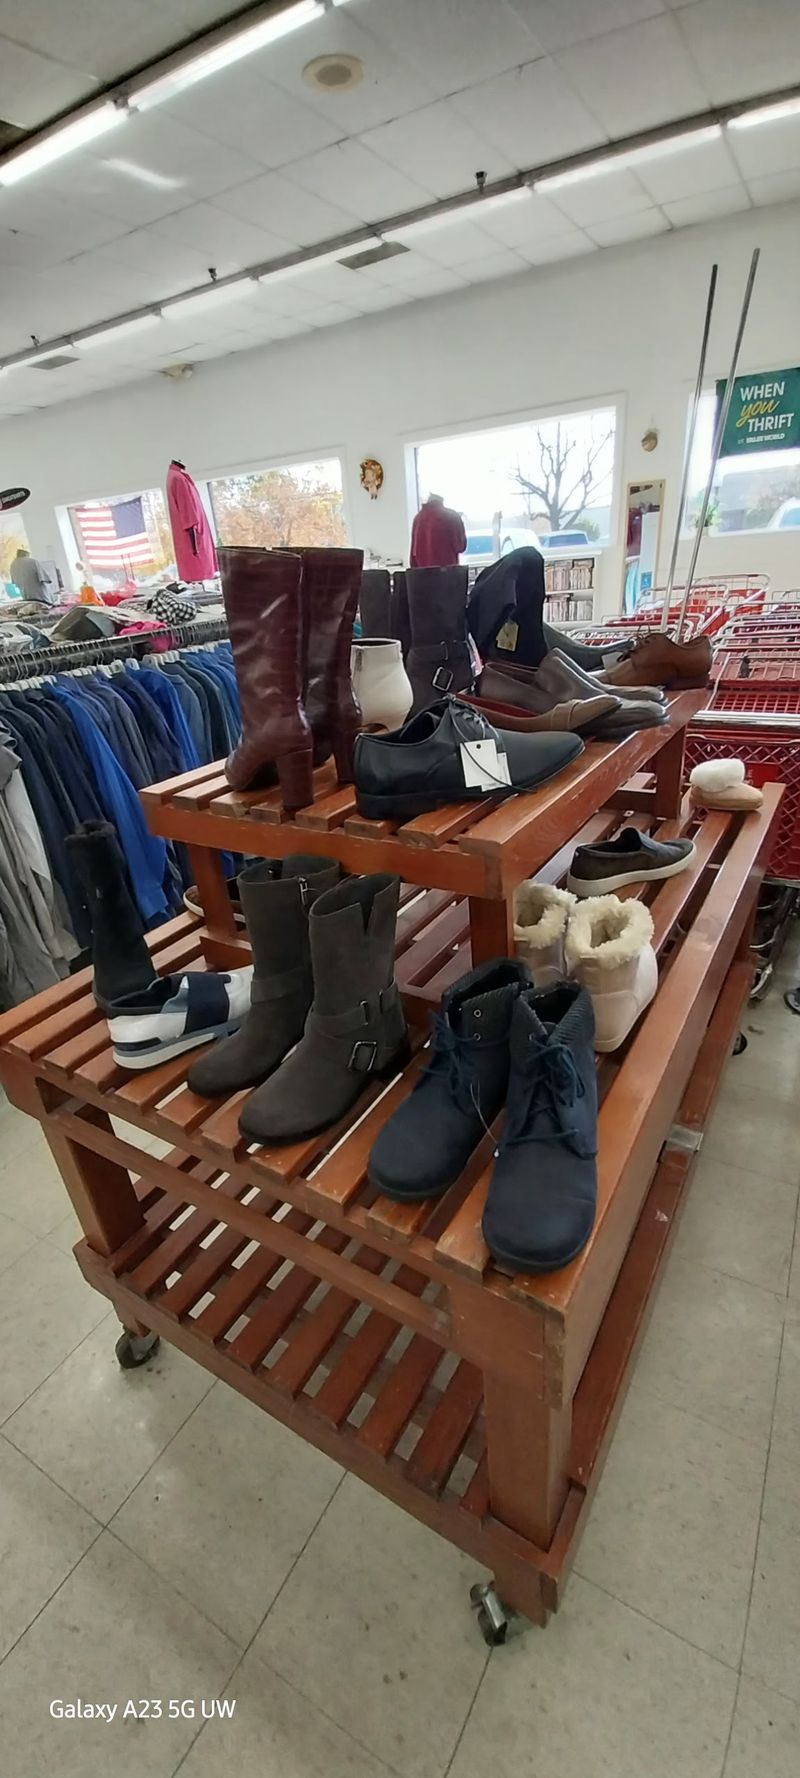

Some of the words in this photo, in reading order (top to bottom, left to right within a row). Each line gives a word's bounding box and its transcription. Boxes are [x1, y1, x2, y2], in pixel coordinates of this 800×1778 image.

[740, 381, 785, 401] WHEN
[736, 400, 780, 427] you
[747, 413, 794, 432] THRIFT
